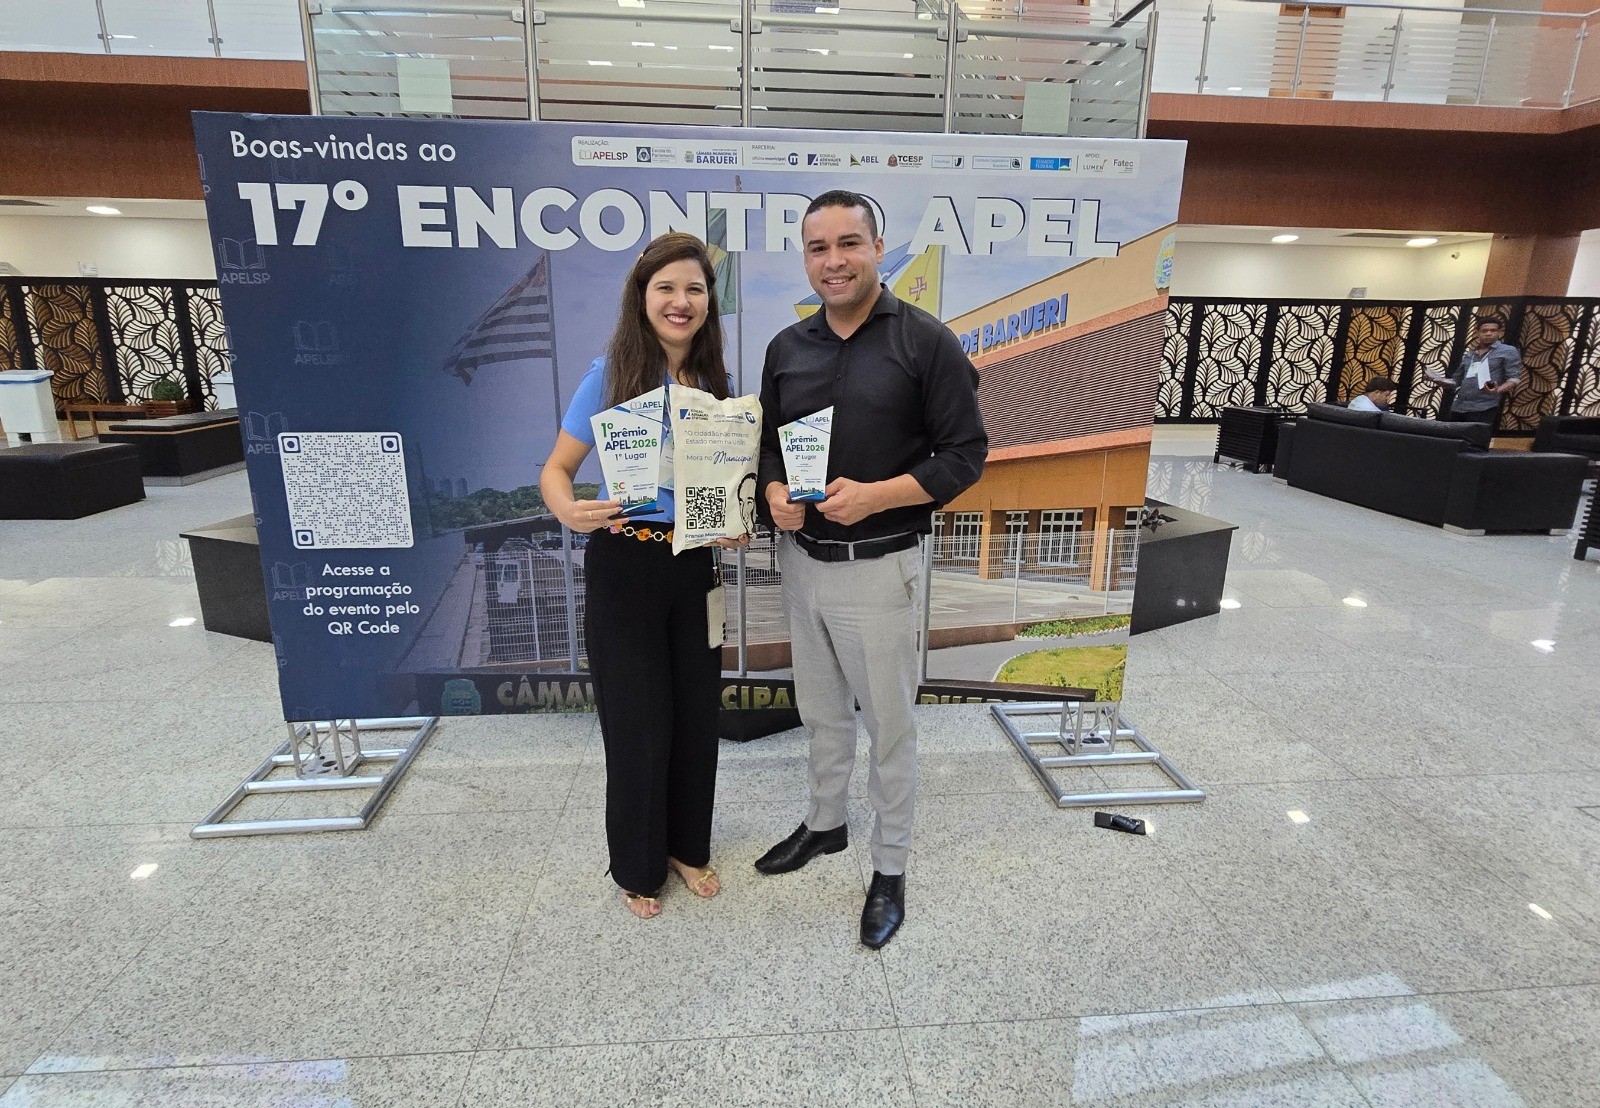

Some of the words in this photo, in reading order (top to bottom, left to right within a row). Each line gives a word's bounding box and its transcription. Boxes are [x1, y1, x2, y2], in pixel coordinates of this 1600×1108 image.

[230, 131, 408, 161] Boas-vindas
[418, 143, 456, 162] ao
[593, 151, 628, 160] APELSP
[696, 155, 738, 165] BARUERI
[861, 156, 879, 164] ABEL
[897, 155, 924, 163] TCESP
[238, 180, 369, 246] 17º
[397, 183, 885, 253] ENCONTR
[906, 196, 1120, 257] APEL
[221, 272, 271, 284] APELSP
[959, 327, 979, 355] DE
[982, 293, 1069, 350] BARUERI
[642, 401, 663, 409] APEL
[610, 426, 648, 441] prêmio
[790, 434, 818, 445] prêmio
[604, 439, 631, 451] APEL
[631, 438, 658, 448] 2026
[785, 444, 805, 452] APEL
[805, 444, 825, 452] 2026
[624, 452, 648, 461] Lugar
[322, 563, 374, 576] Acesse
[379, 565, 391, 576] a
[305, 582, 413, 599] programação
[303, 602, 324, 616] do
[329, 603, 380, 615] evento
[385, 601, 420, 617] pelo
[327, 621, 353, 635] QR
[357, 620, 400, 634] Code
